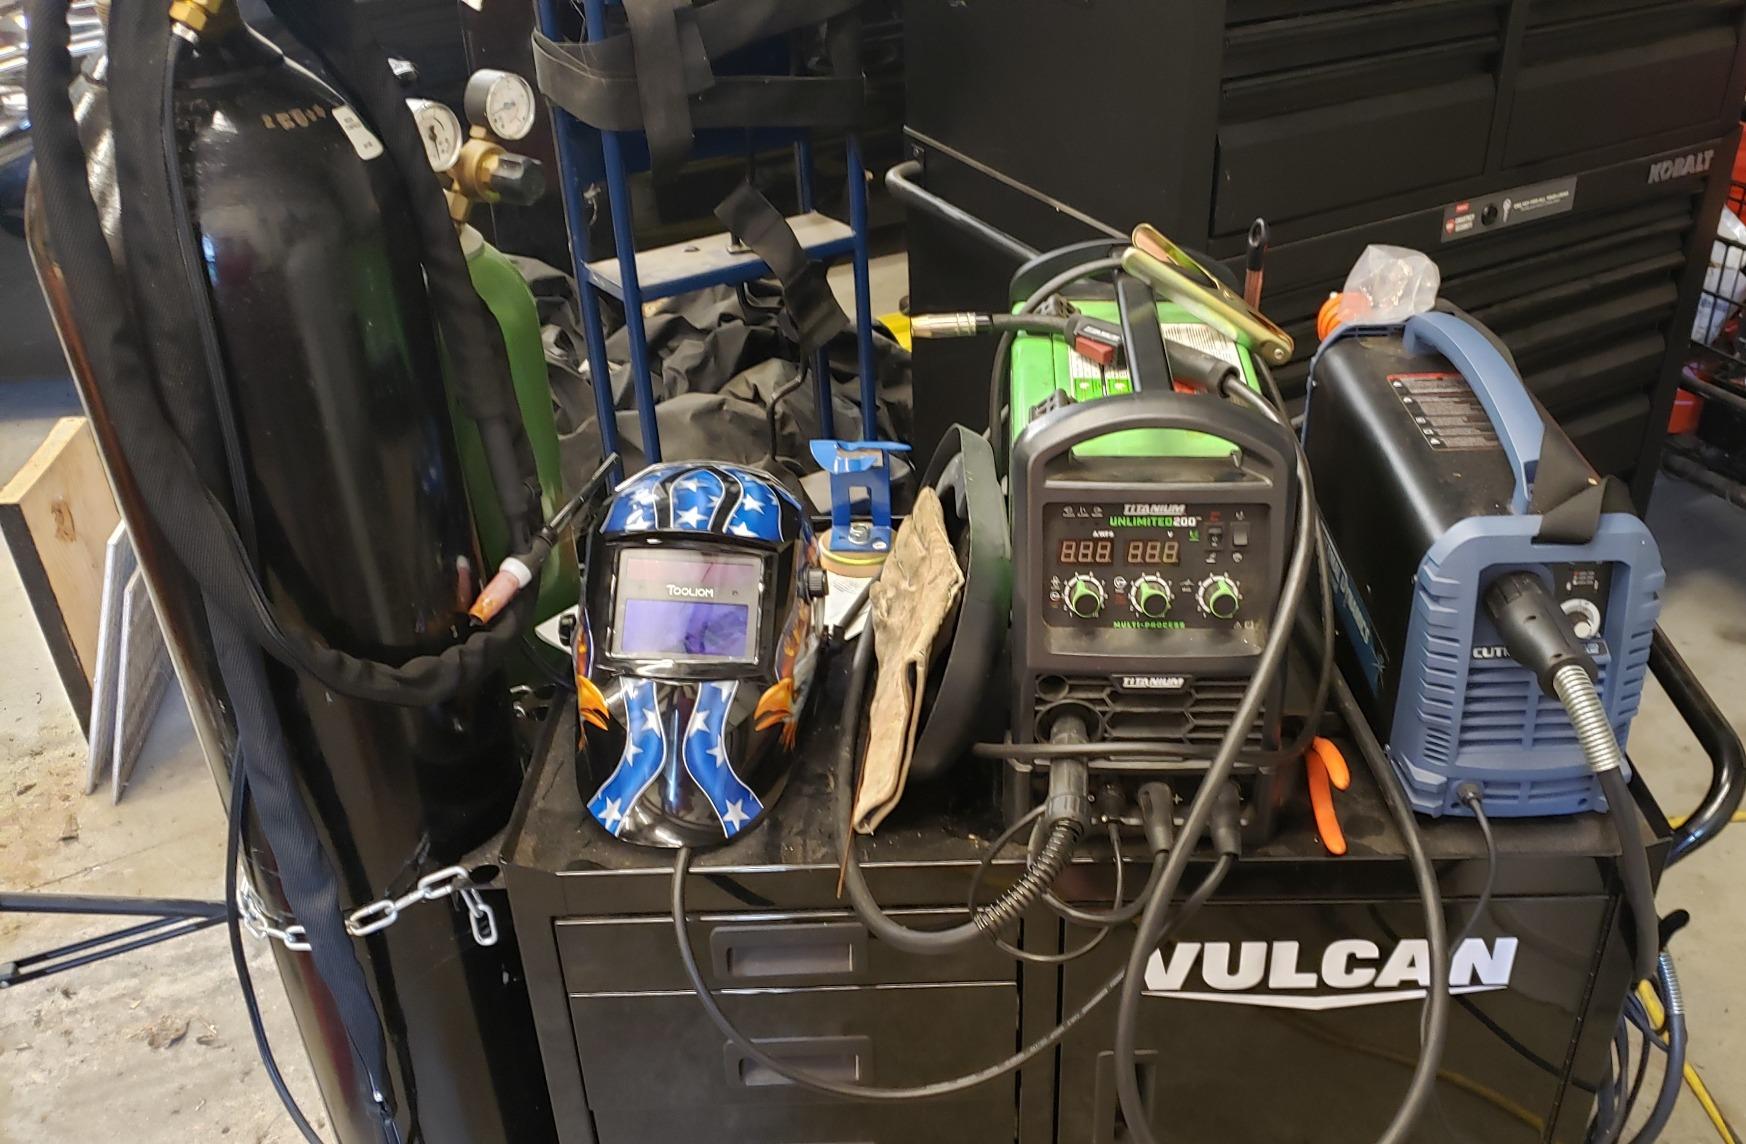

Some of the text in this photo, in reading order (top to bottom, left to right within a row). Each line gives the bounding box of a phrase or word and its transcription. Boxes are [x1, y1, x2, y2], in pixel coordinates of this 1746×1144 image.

[1648, 150, 1714, 184] KOBALT
[1123, 504, 1186, 515] TITANIUM
[666, 584, 714, 598] TOOLIOM
[1122, 677, 1185, 688] TITANIUM
[1144, 937, 1519, 990] VULCAN
